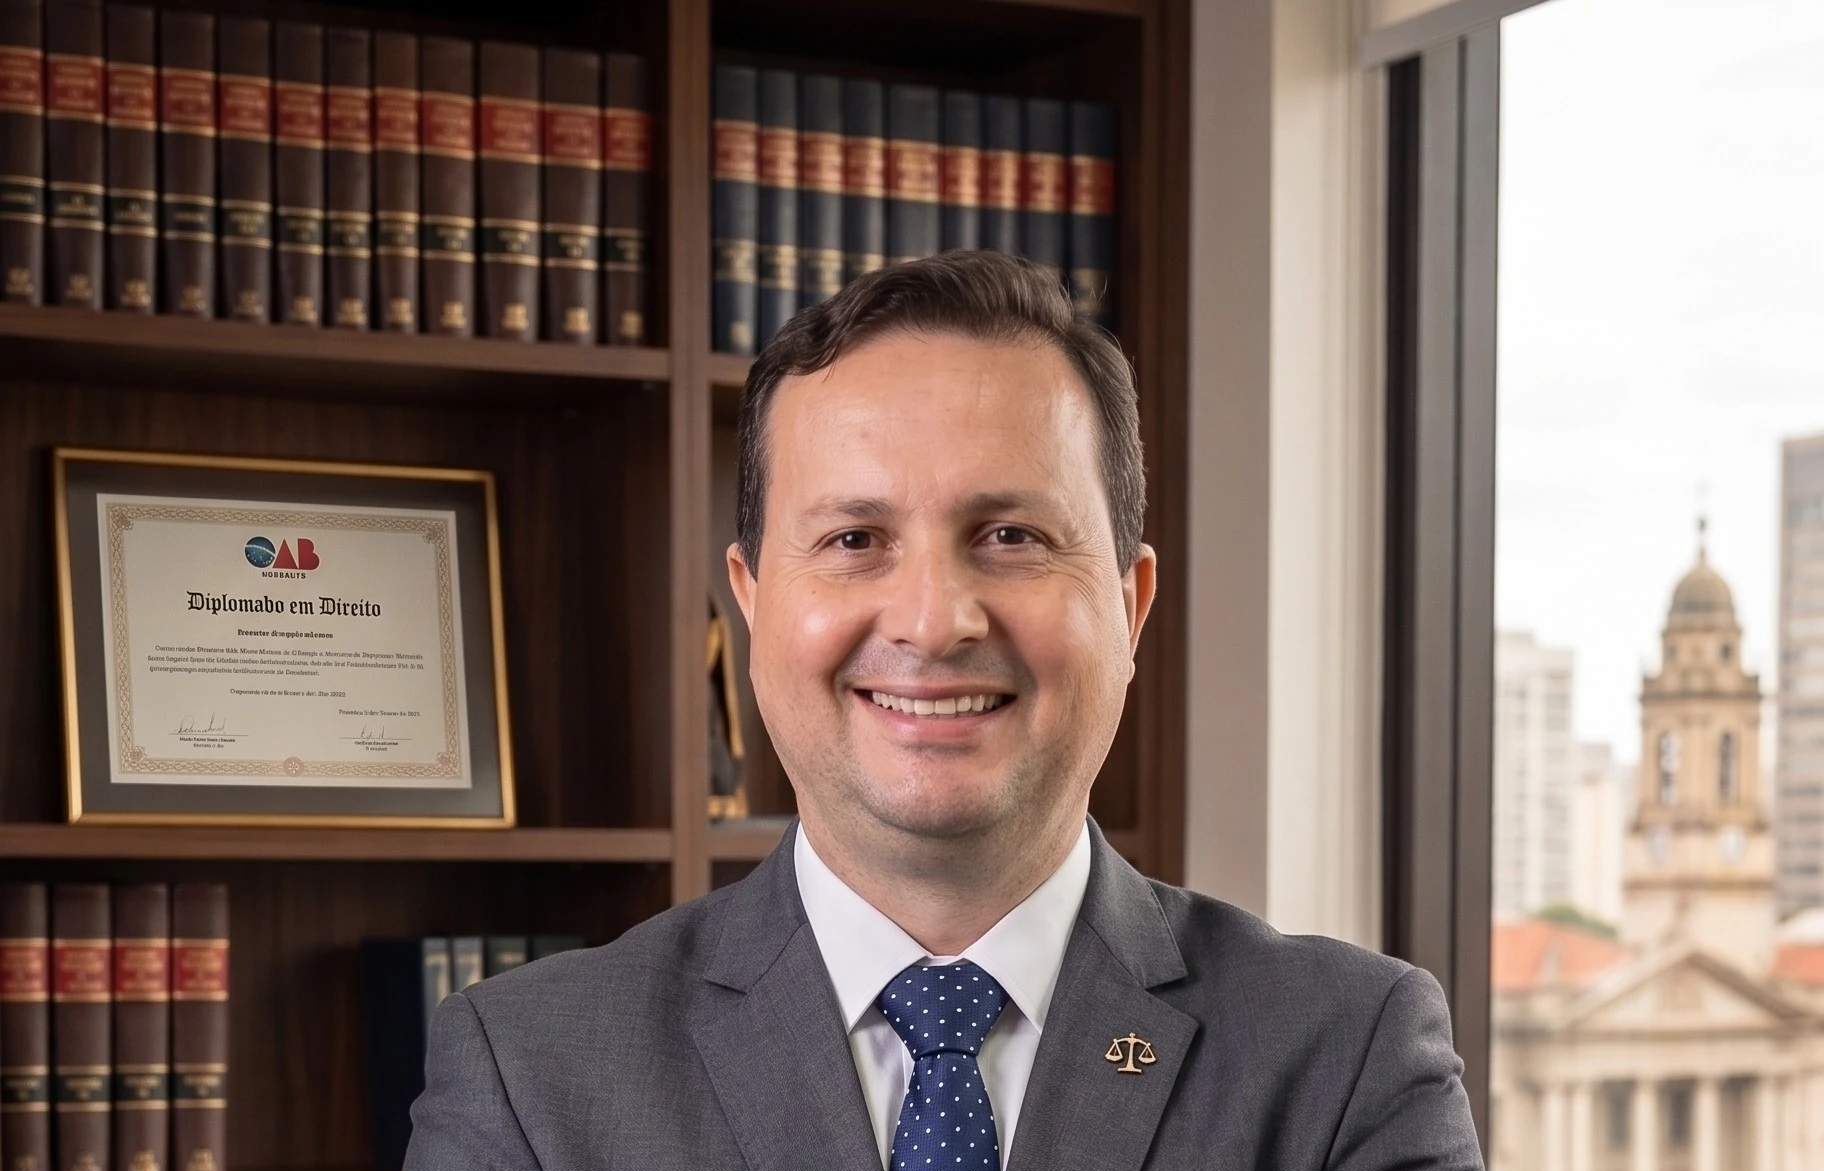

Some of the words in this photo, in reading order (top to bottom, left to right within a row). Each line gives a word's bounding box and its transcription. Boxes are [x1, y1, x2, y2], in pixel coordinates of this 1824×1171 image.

[245, 536, 320, 571] OAB
[289, 599, 315, 615] em
[319, 596, 381, 617] Direito
